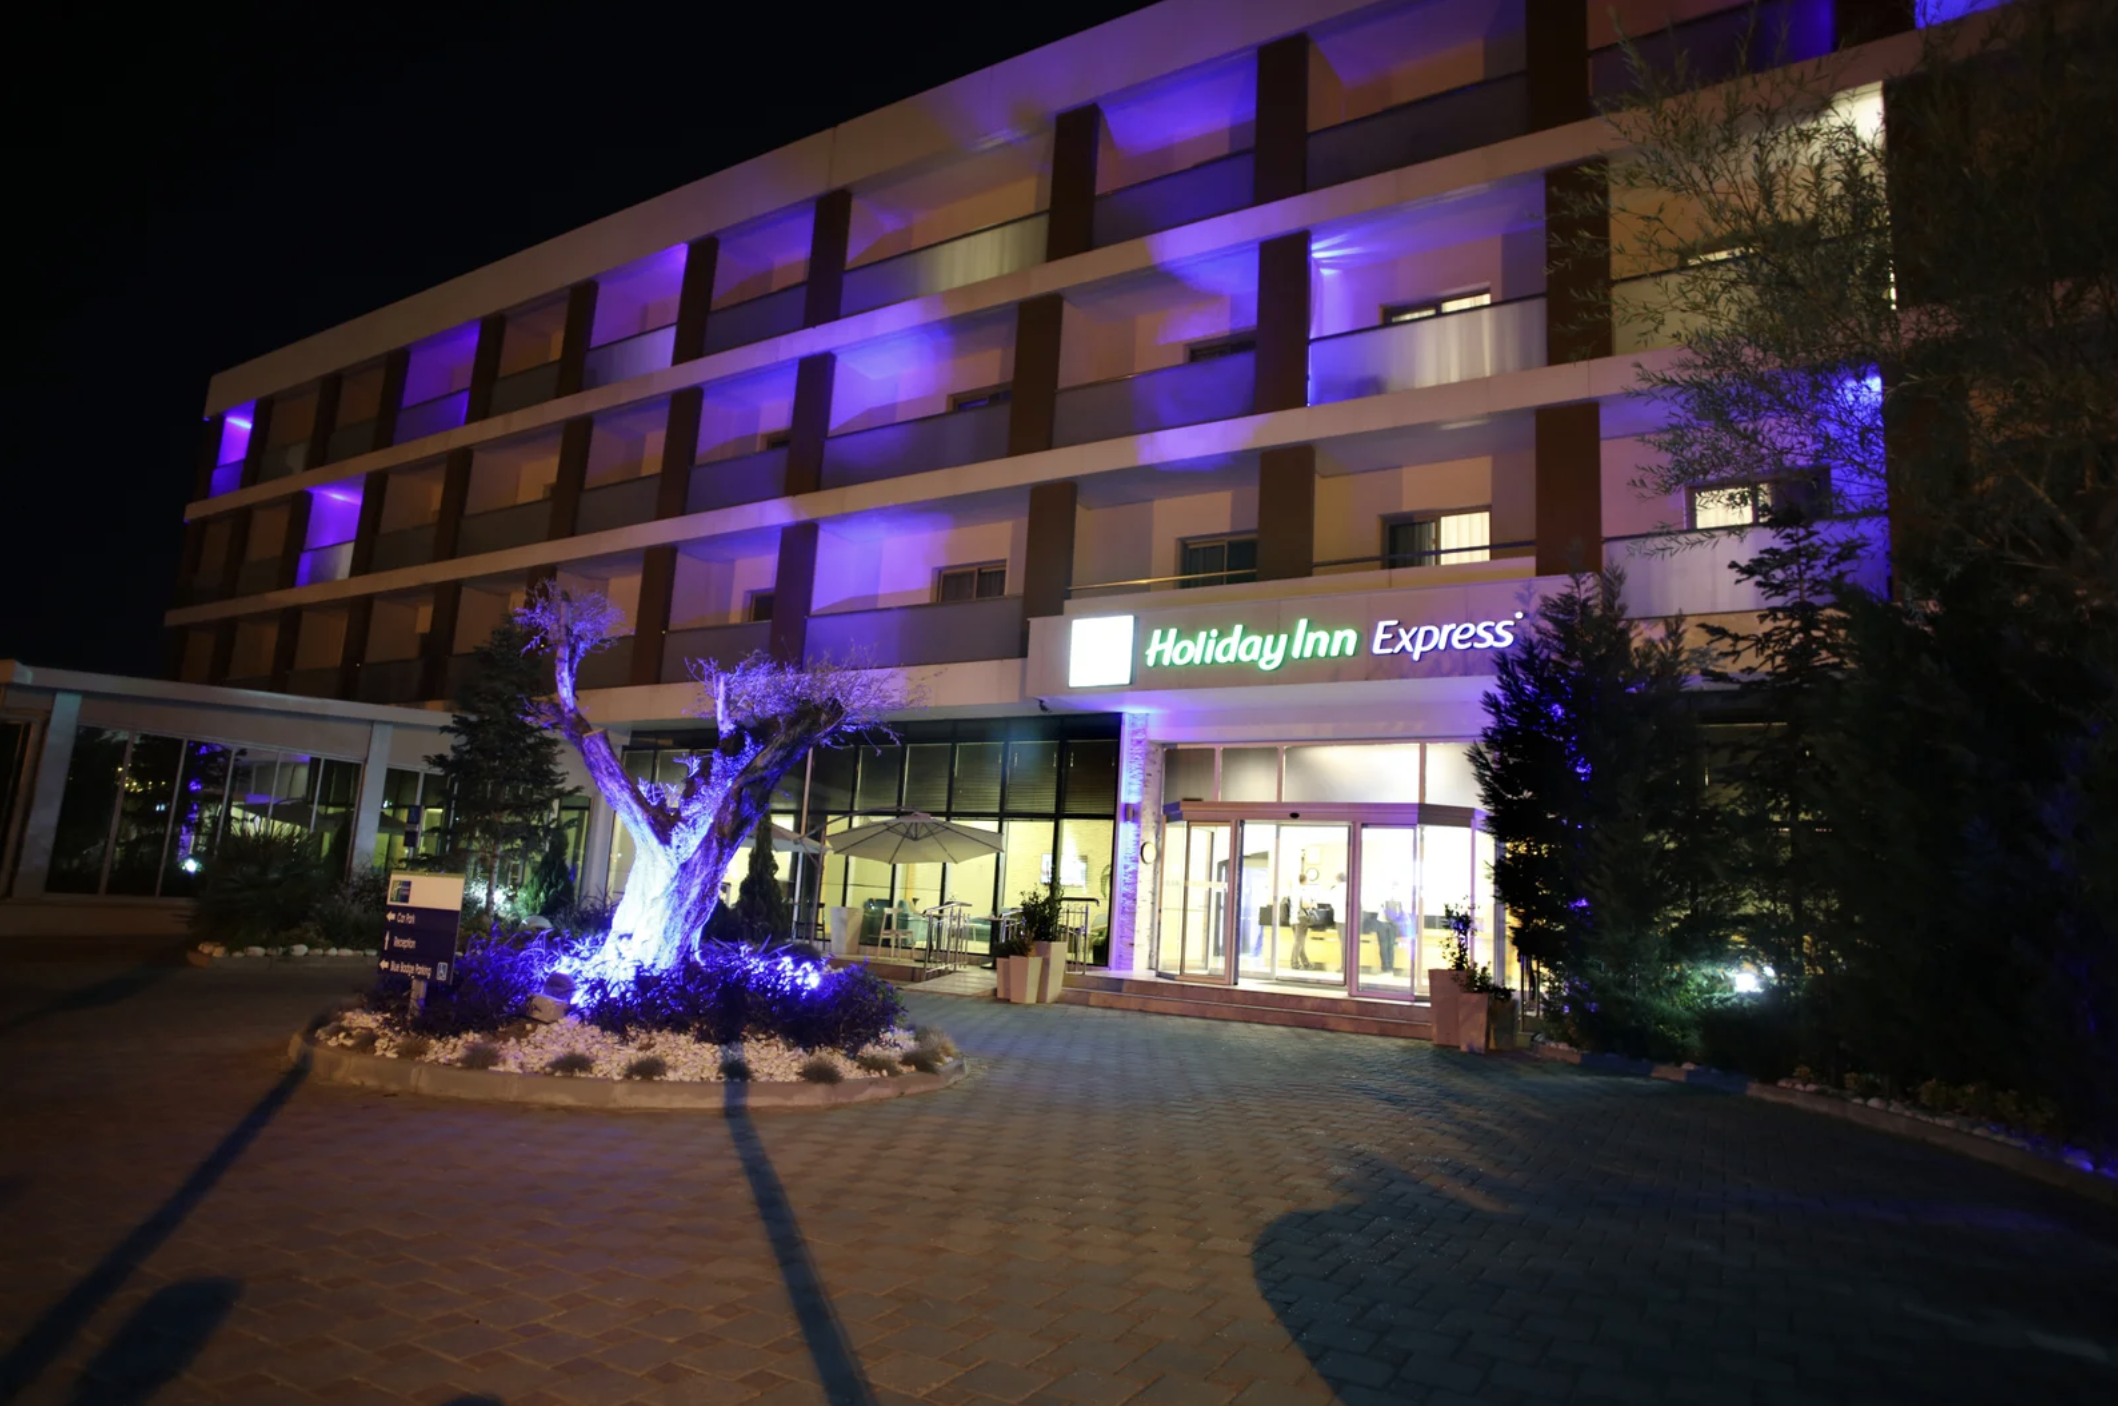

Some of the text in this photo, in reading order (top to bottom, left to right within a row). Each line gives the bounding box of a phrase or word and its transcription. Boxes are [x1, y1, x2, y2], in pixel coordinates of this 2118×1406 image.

[1145, 618, 1515, 671] Holiday Inn Express
[394, 936, 416, 949] Reception
[415, 964, 432, 979] Parking
